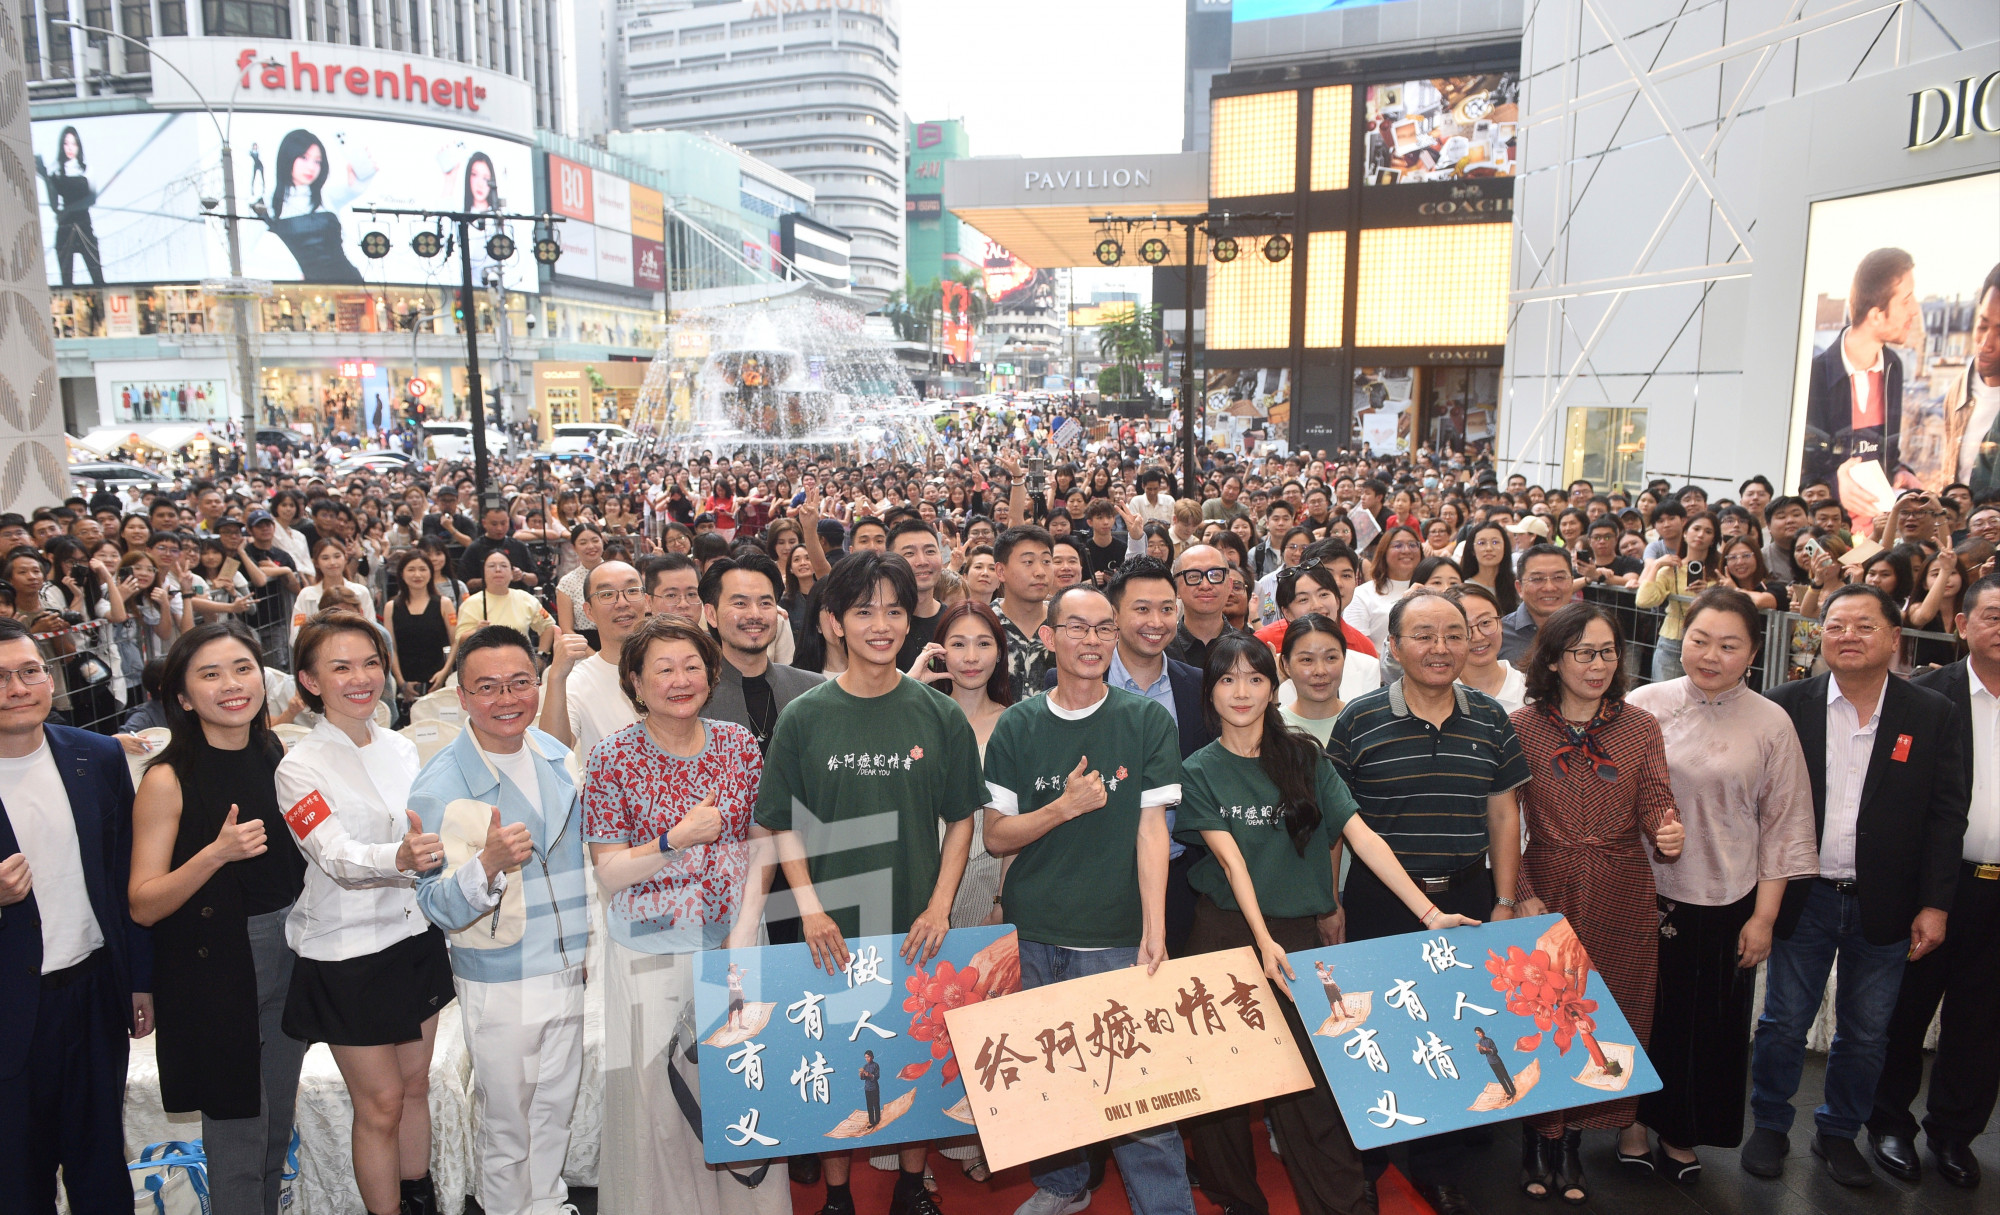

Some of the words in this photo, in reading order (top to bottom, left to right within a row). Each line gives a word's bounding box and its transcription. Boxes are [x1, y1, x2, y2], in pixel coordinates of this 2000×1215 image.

[236, 49, 479, 111] fahrenheit
[560, 163, 584, 209] BO
[1025, 168, 1152, 191] PAVILION
[1418, 198, 1514, 215] COACH
[110, 295, 129, 313] UT
[1428, 350, 1488, 360] COACH
[1858, 440, 1878, 454] Dior
[301, 811, 316, 826] VIP
[1384, 978, 1461, 1081] 有情
[785, 990, 836, 1105] 有情
[1104, 1102, 1133, 1123] ONLY
[1136, 1098, 1150, 1115] IN
[1151, 1087, 1202, 1111] CINEMAS
